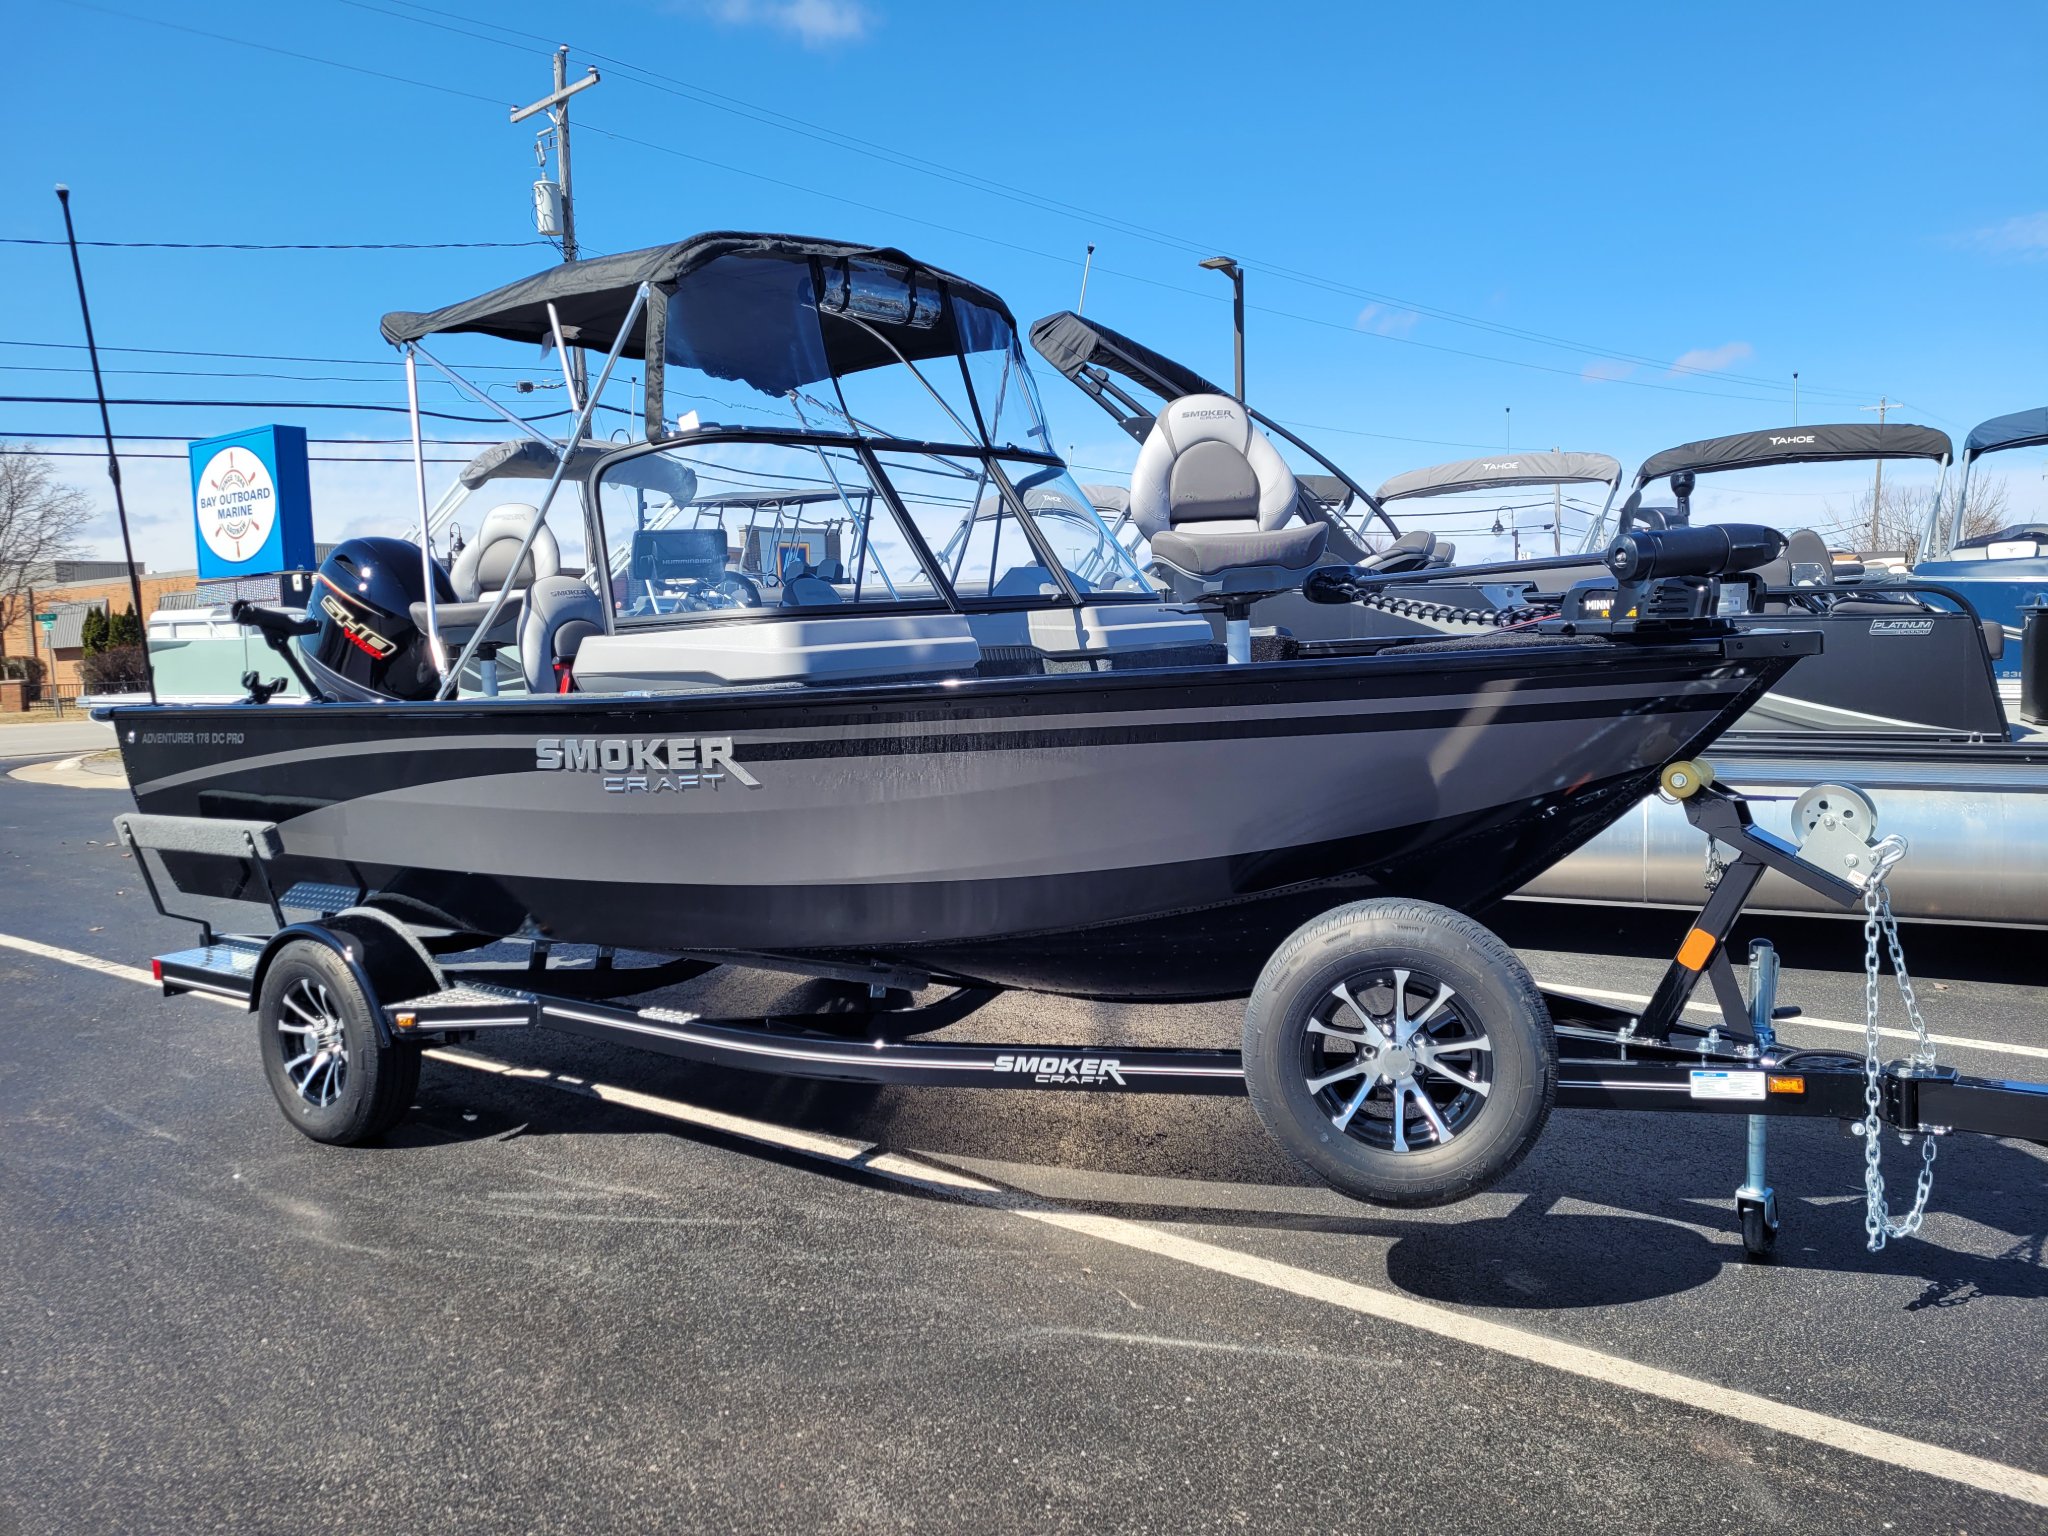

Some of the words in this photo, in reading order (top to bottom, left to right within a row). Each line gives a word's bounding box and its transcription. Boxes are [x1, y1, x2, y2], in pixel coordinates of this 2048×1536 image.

[1181, 409, 1235, 420] SMOKER
[1769, 435, 1815, 445] TAHOE
[1482, 461, 1519, 471] TAHOE
[200, 496, 217, 509] BAY
[219, 487, 271, 505] OUTBOARD
[217, 504, 253, 520] MARINE
[550, 589, 589, 598] SMOKER
[1585, 599, 1610, 611] MINN
[1873, 621, 1932, 629] PLATINUM
[142, 732, 194, 744] ADVENTURER
[196, 732, 210, 744] 178
[211, 732, 225, 744] DC
[226, 732, 245, 744] PRO
[536, 737, 761, 787] SMOKER
[603, 773, 726, 791] CRAFT
[993, 1055, 1127, 1086] SMOKER
[1034, 1074, 1108, 1085] CRAFT
